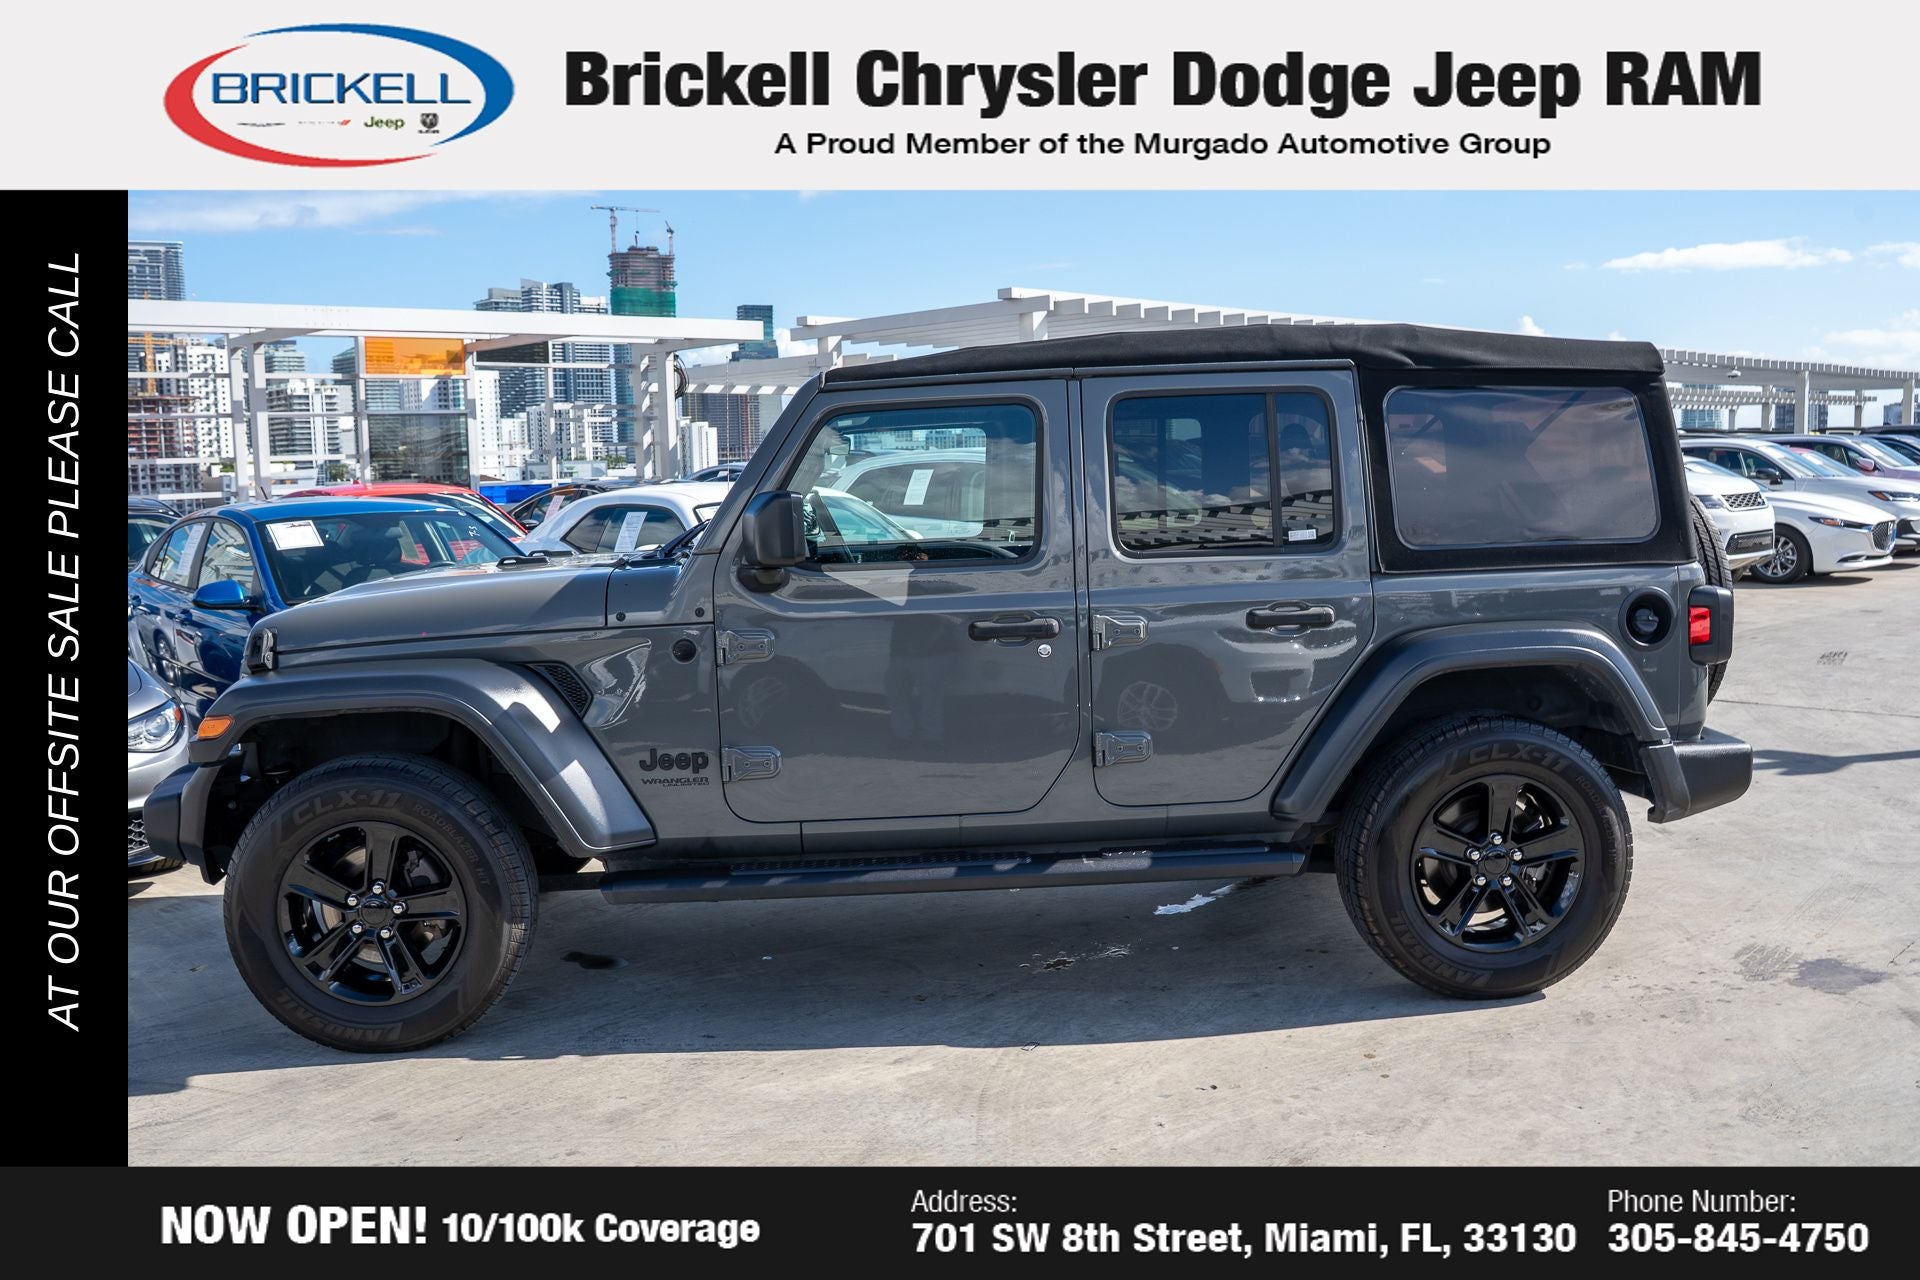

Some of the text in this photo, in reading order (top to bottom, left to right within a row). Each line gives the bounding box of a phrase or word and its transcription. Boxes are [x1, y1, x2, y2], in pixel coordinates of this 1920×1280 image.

[639, 748, 709, 774] Jeep
[1469, 743, 1574, 773] CLX-11
[641, 776, 709, 785] WRANGLER
[291, 788, 403, 827] CLX-11
